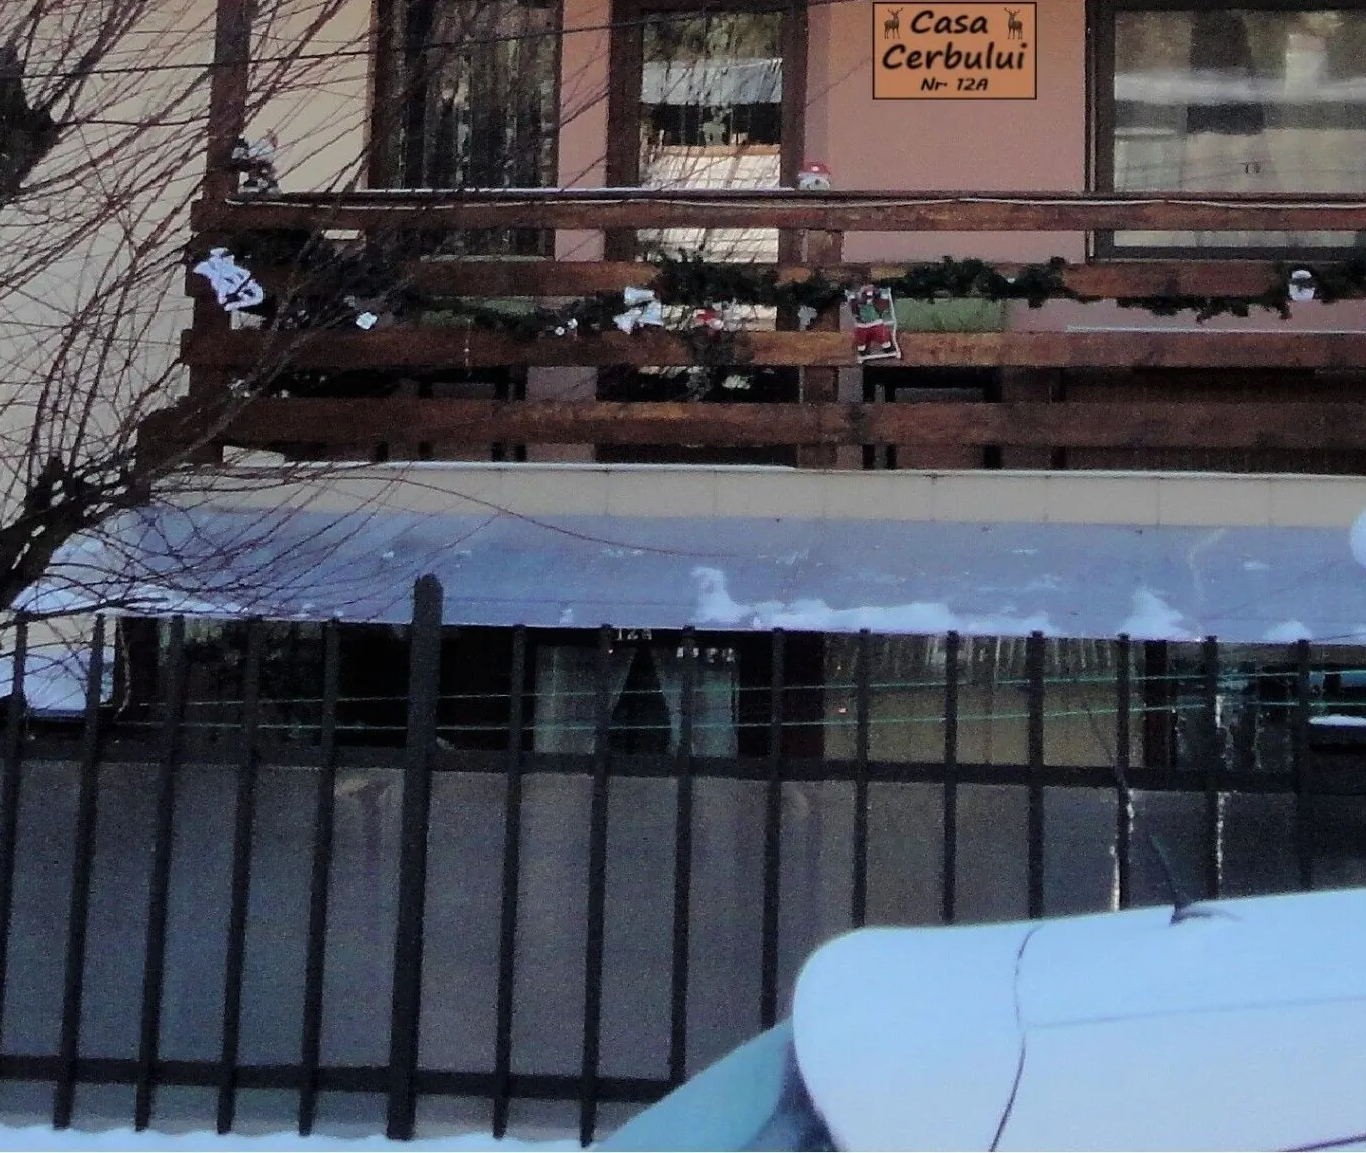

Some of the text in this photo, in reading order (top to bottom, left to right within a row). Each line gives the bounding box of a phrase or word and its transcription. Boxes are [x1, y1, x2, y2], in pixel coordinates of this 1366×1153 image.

[910, 10, 989, 34] Casa
[882, 41, 1029, 70] Cerbului
[956, 77, 989, 91] 12A
